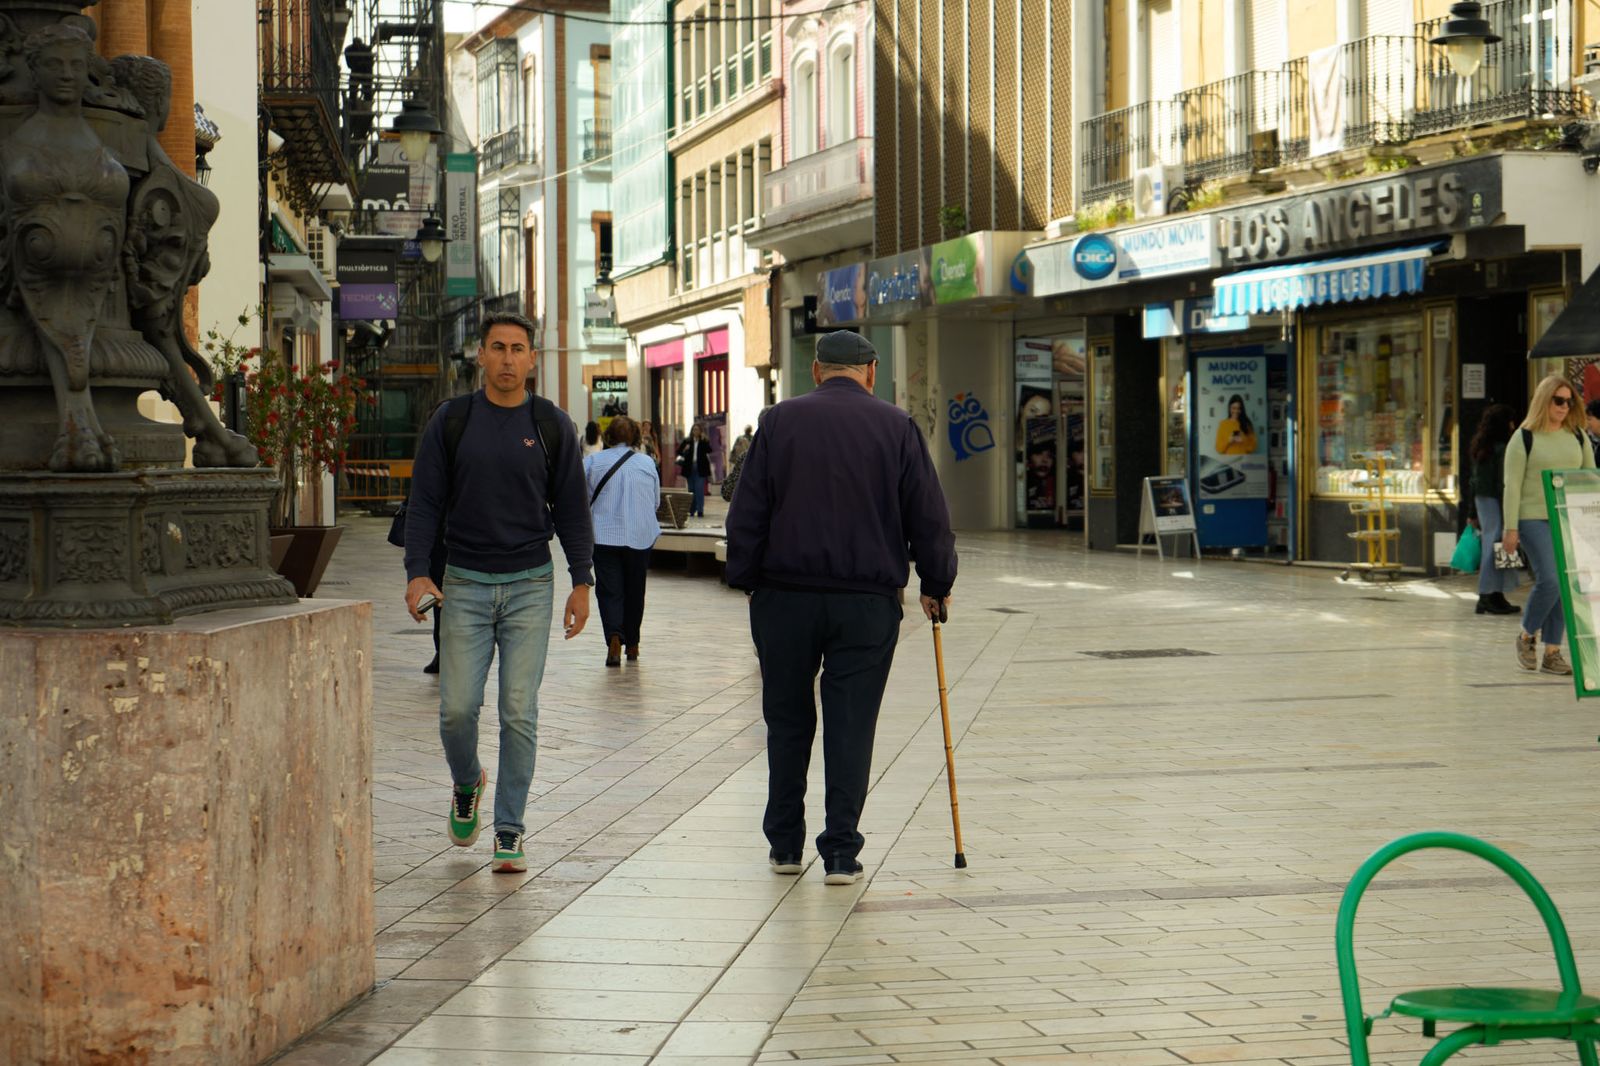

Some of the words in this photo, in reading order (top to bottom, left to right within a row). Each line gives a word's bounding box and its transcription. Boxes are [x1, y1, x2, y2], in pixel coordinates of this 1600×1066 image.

[1227, 206, 1289, 259] LOS
[1302, 172, 1461, 248] ANGELES
[1122, 228, 1166, 252] MUNDO
[1076, 252, 1115, 263] DIGI
[1289, 270, 1371, 301] ANGELES
[1208, 361, 1259, 372] MUNDO
